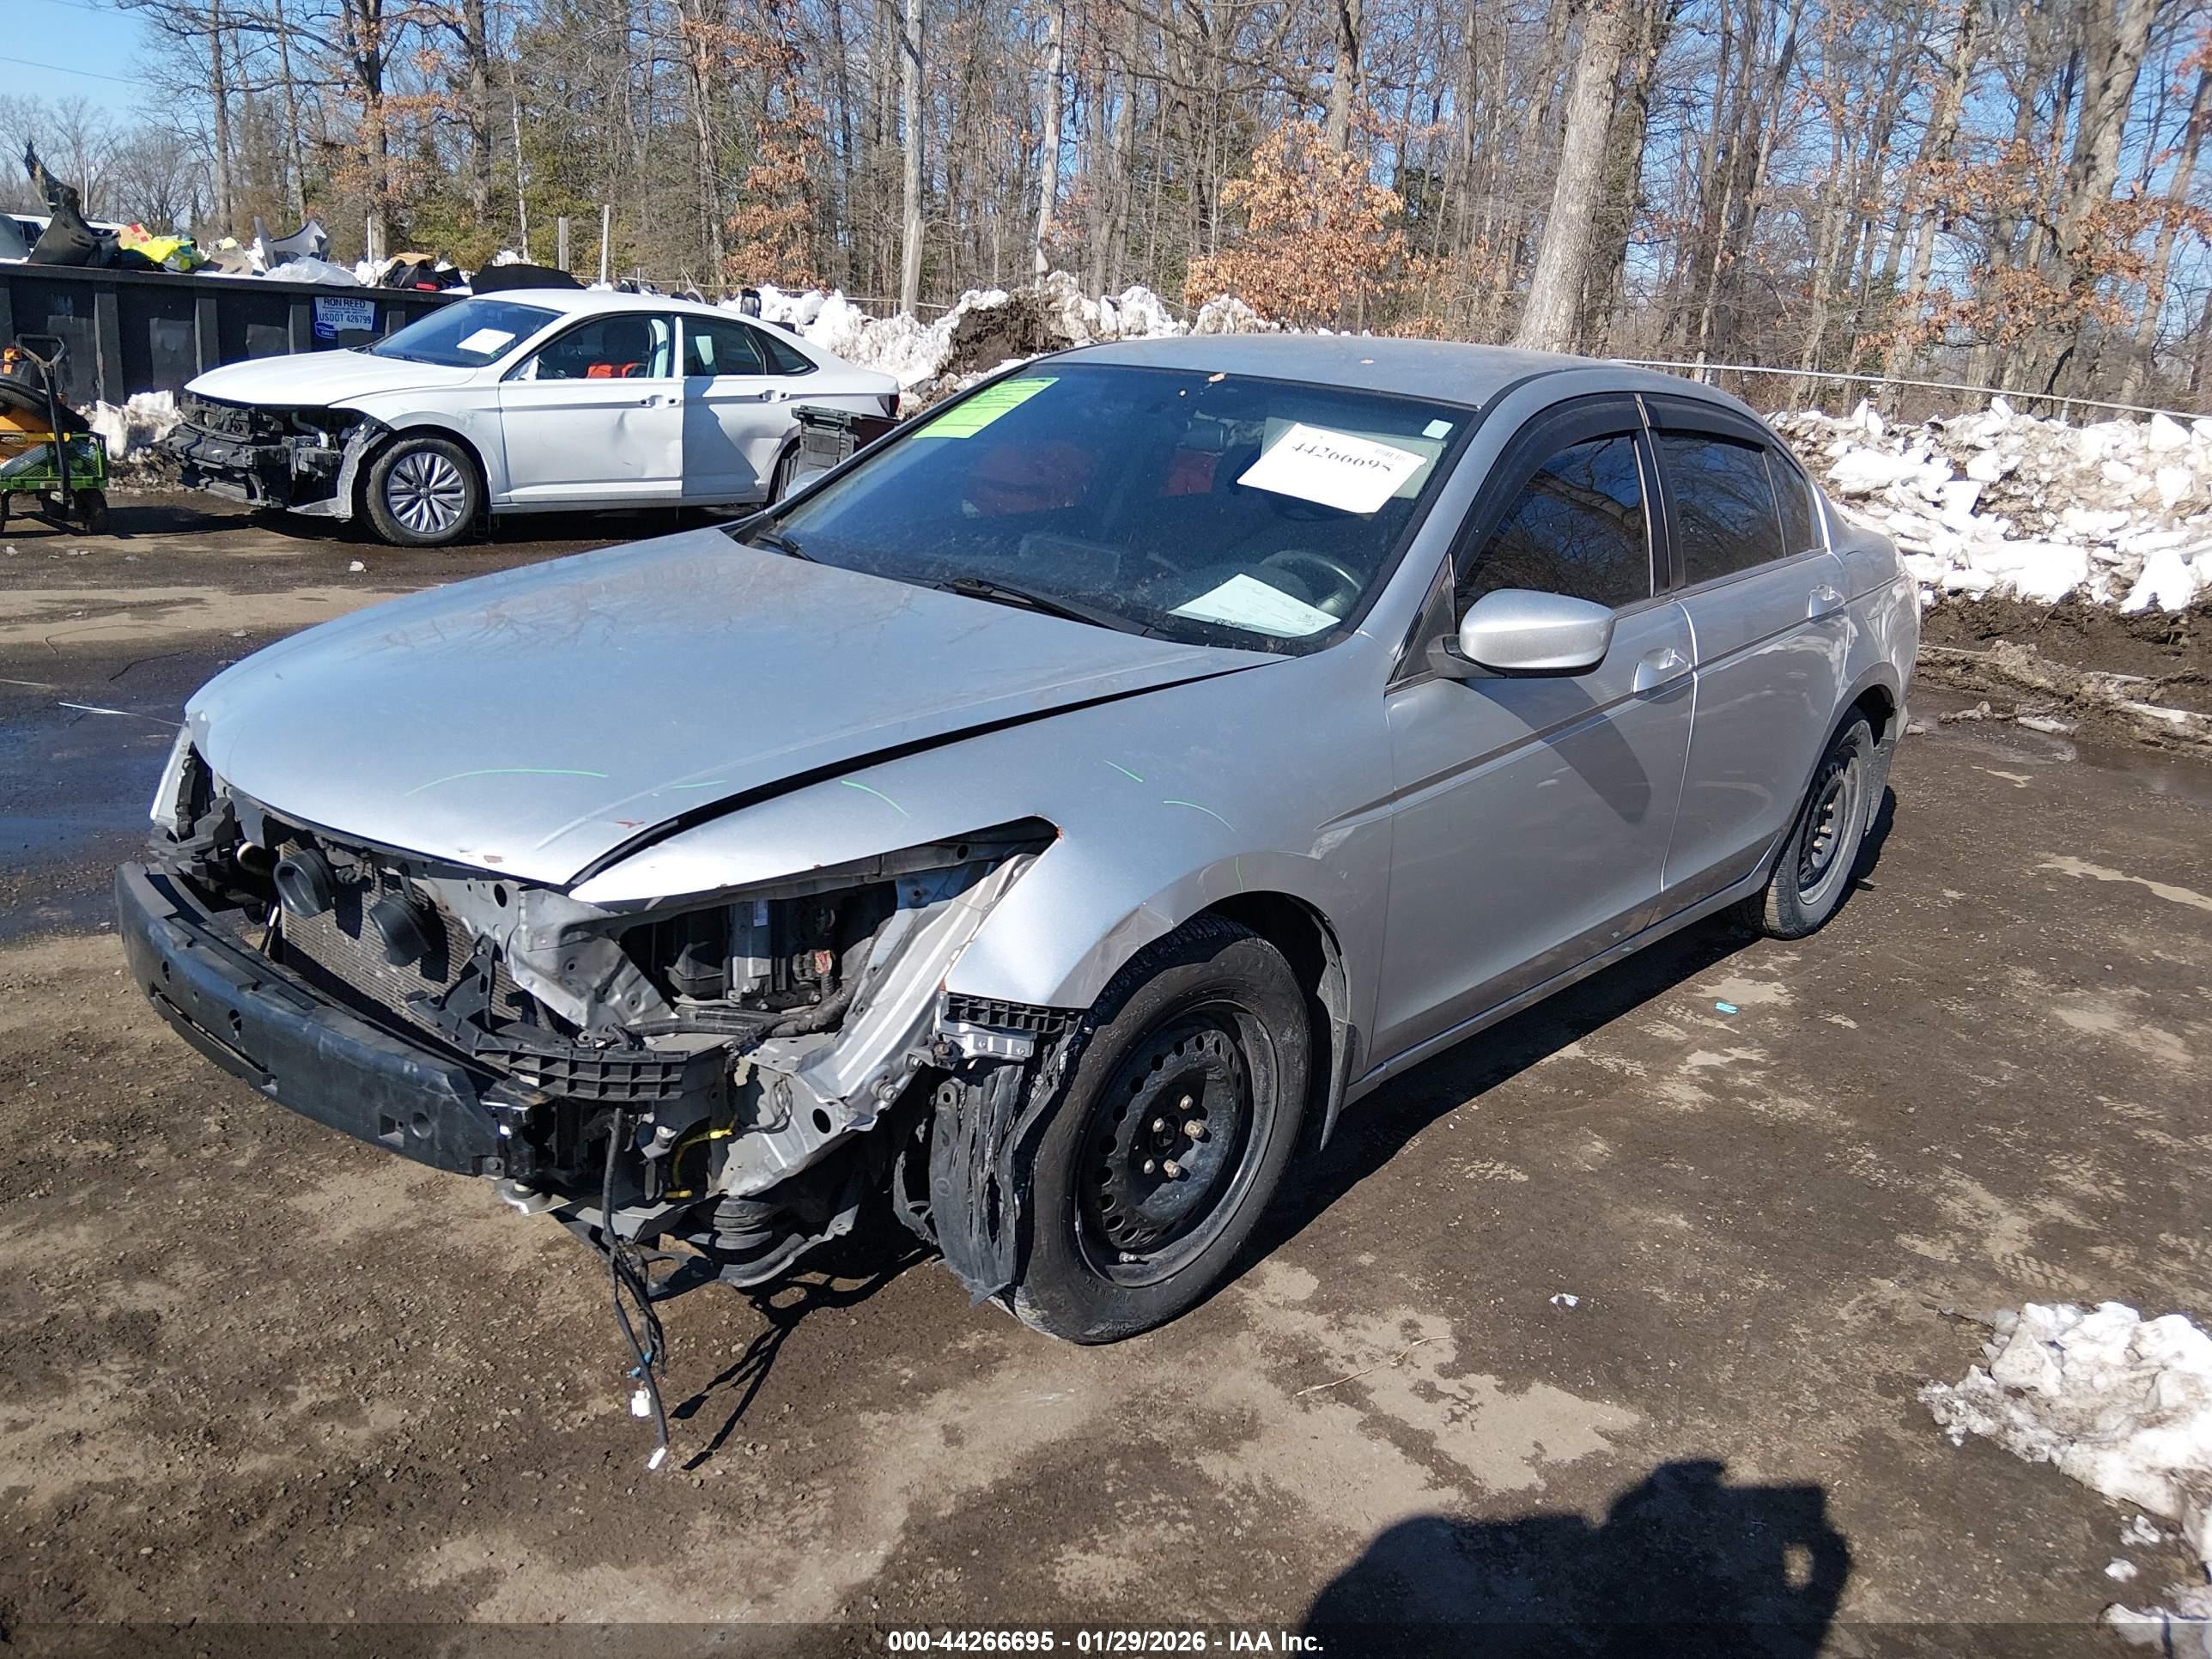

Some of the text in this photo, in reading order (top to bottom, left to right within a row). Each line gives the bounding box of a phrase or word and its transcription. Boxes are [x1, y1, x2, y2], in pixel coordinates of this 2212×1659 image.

[324, 297, 366, 308] RON REED
[319, 313, 372, 325] USDOT 426799
